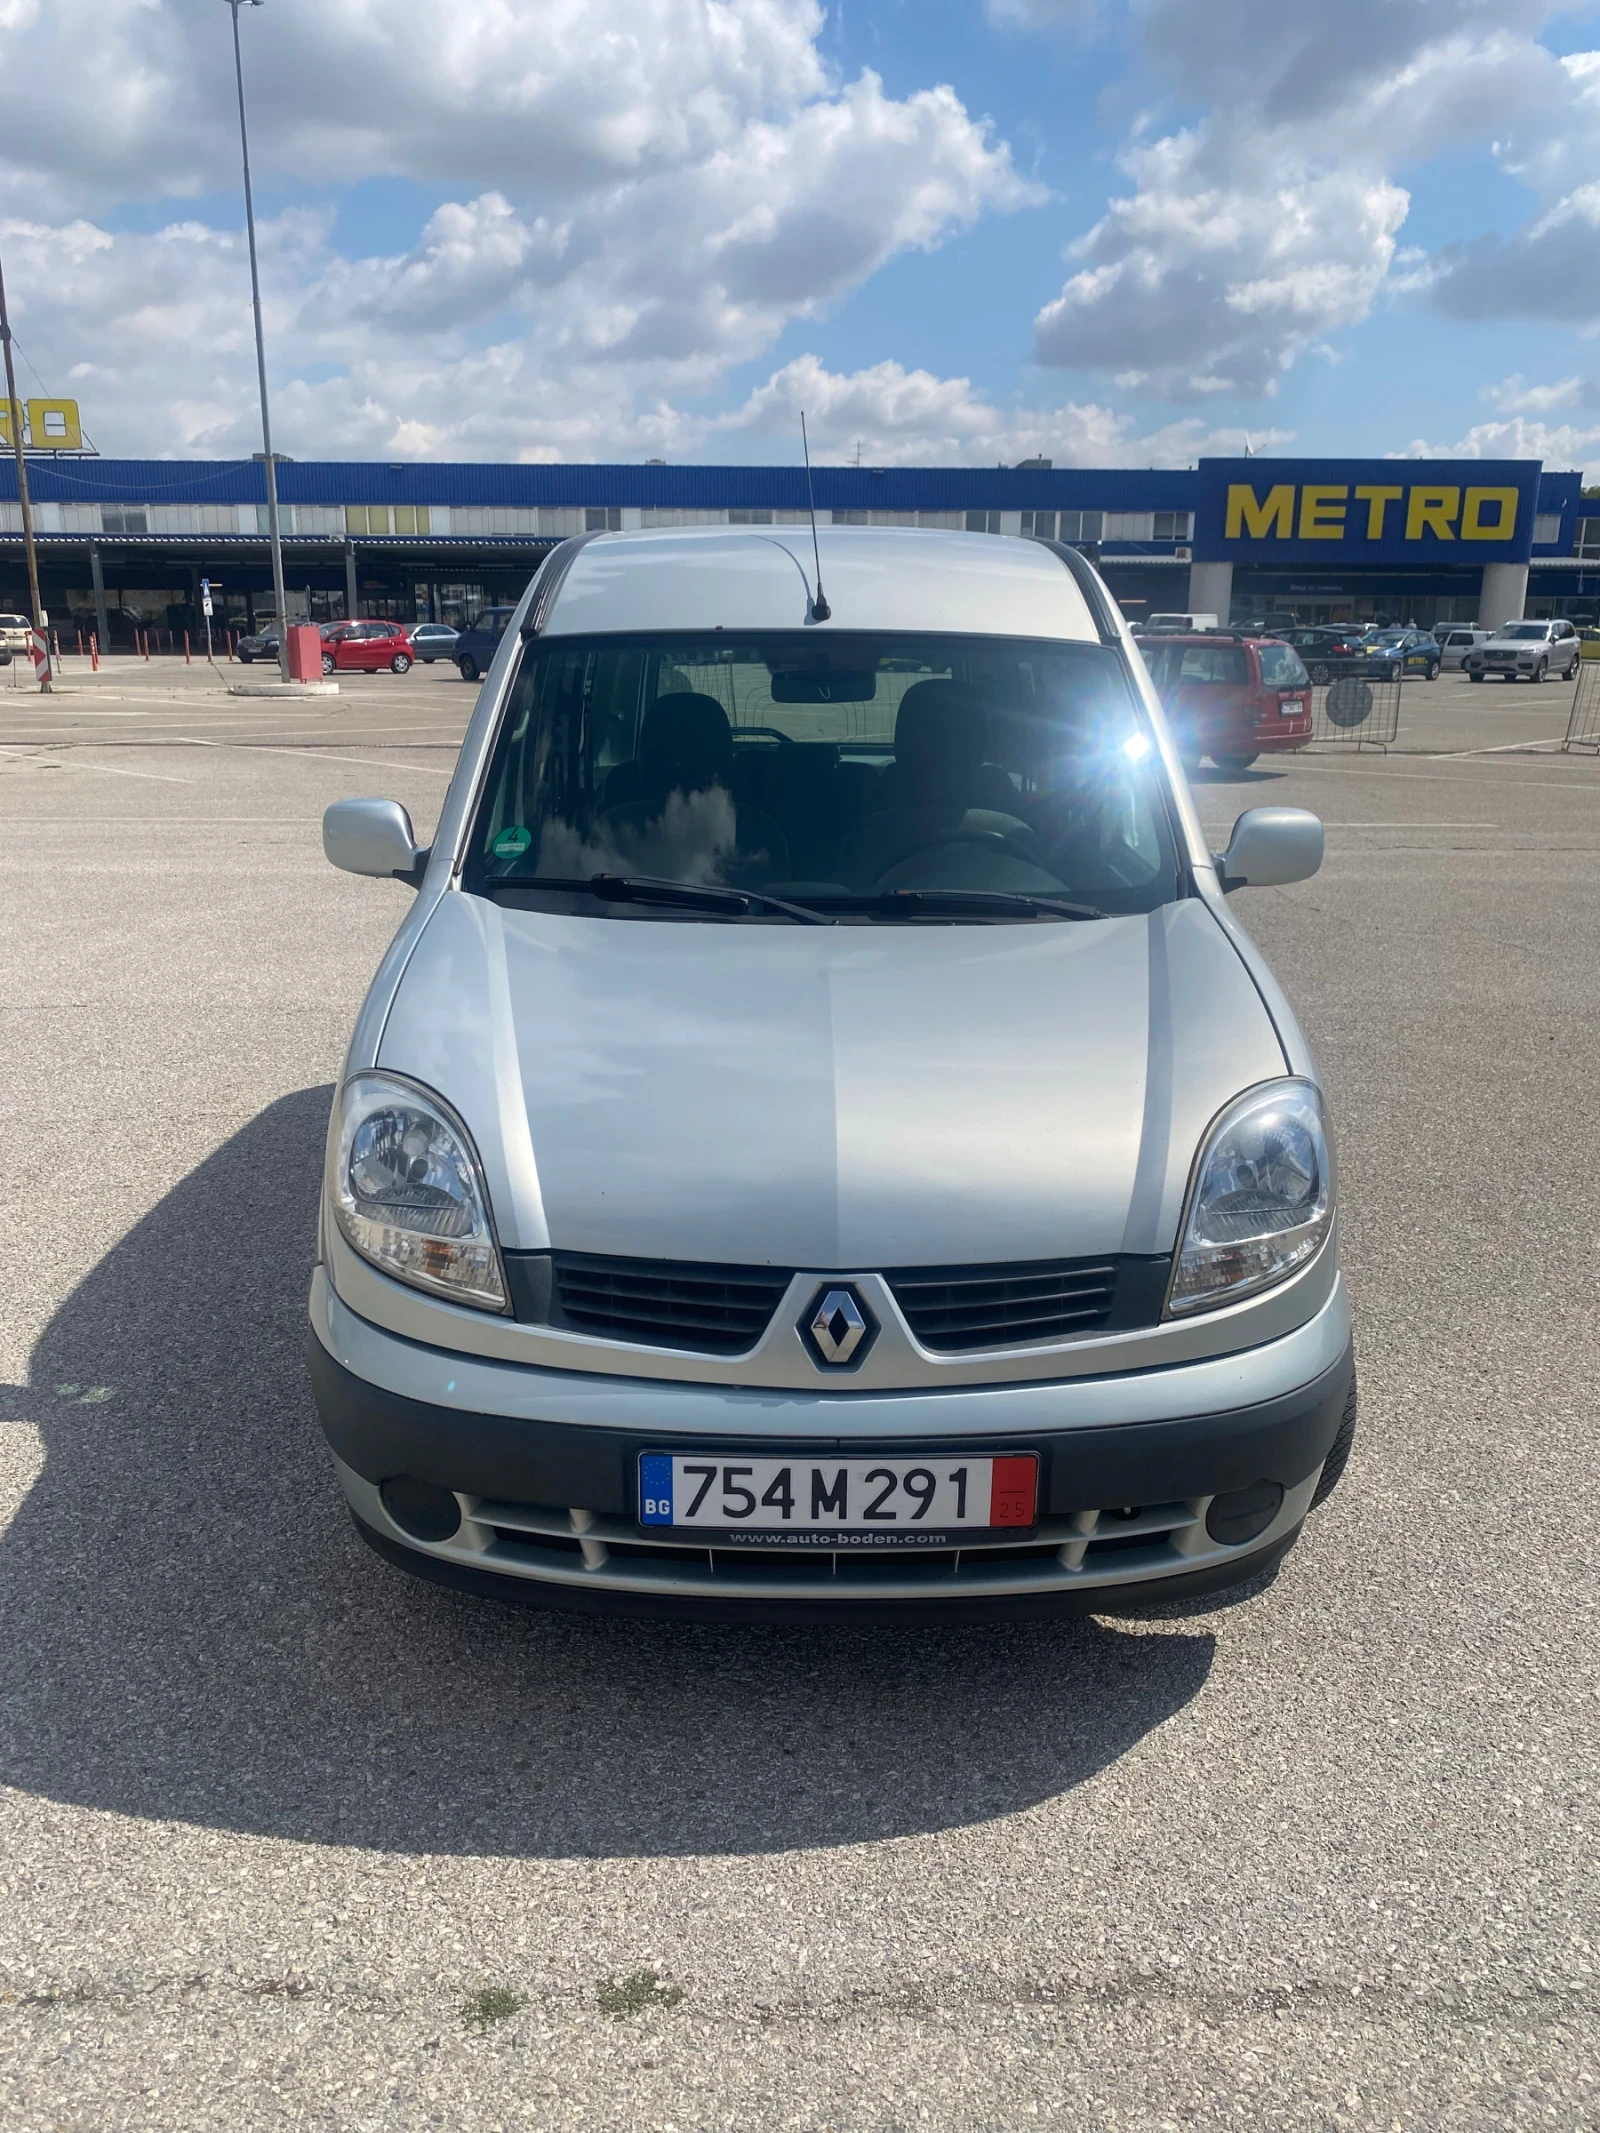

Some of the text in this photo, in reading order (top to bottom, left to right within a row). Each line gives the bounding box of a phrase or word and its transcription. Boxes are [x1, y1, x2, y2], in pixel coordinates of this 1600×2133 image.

[1225, 484, 1519, 541] METRO
[507, 827, 518, 842] 4
[682, 1465, 968, 1521] 754 M 291
[645, 1498, 671, 1515] BG
[999, 1502, 1025, 1519] 25
[729, 1531, 947, 1545] www.auto-boden.com
